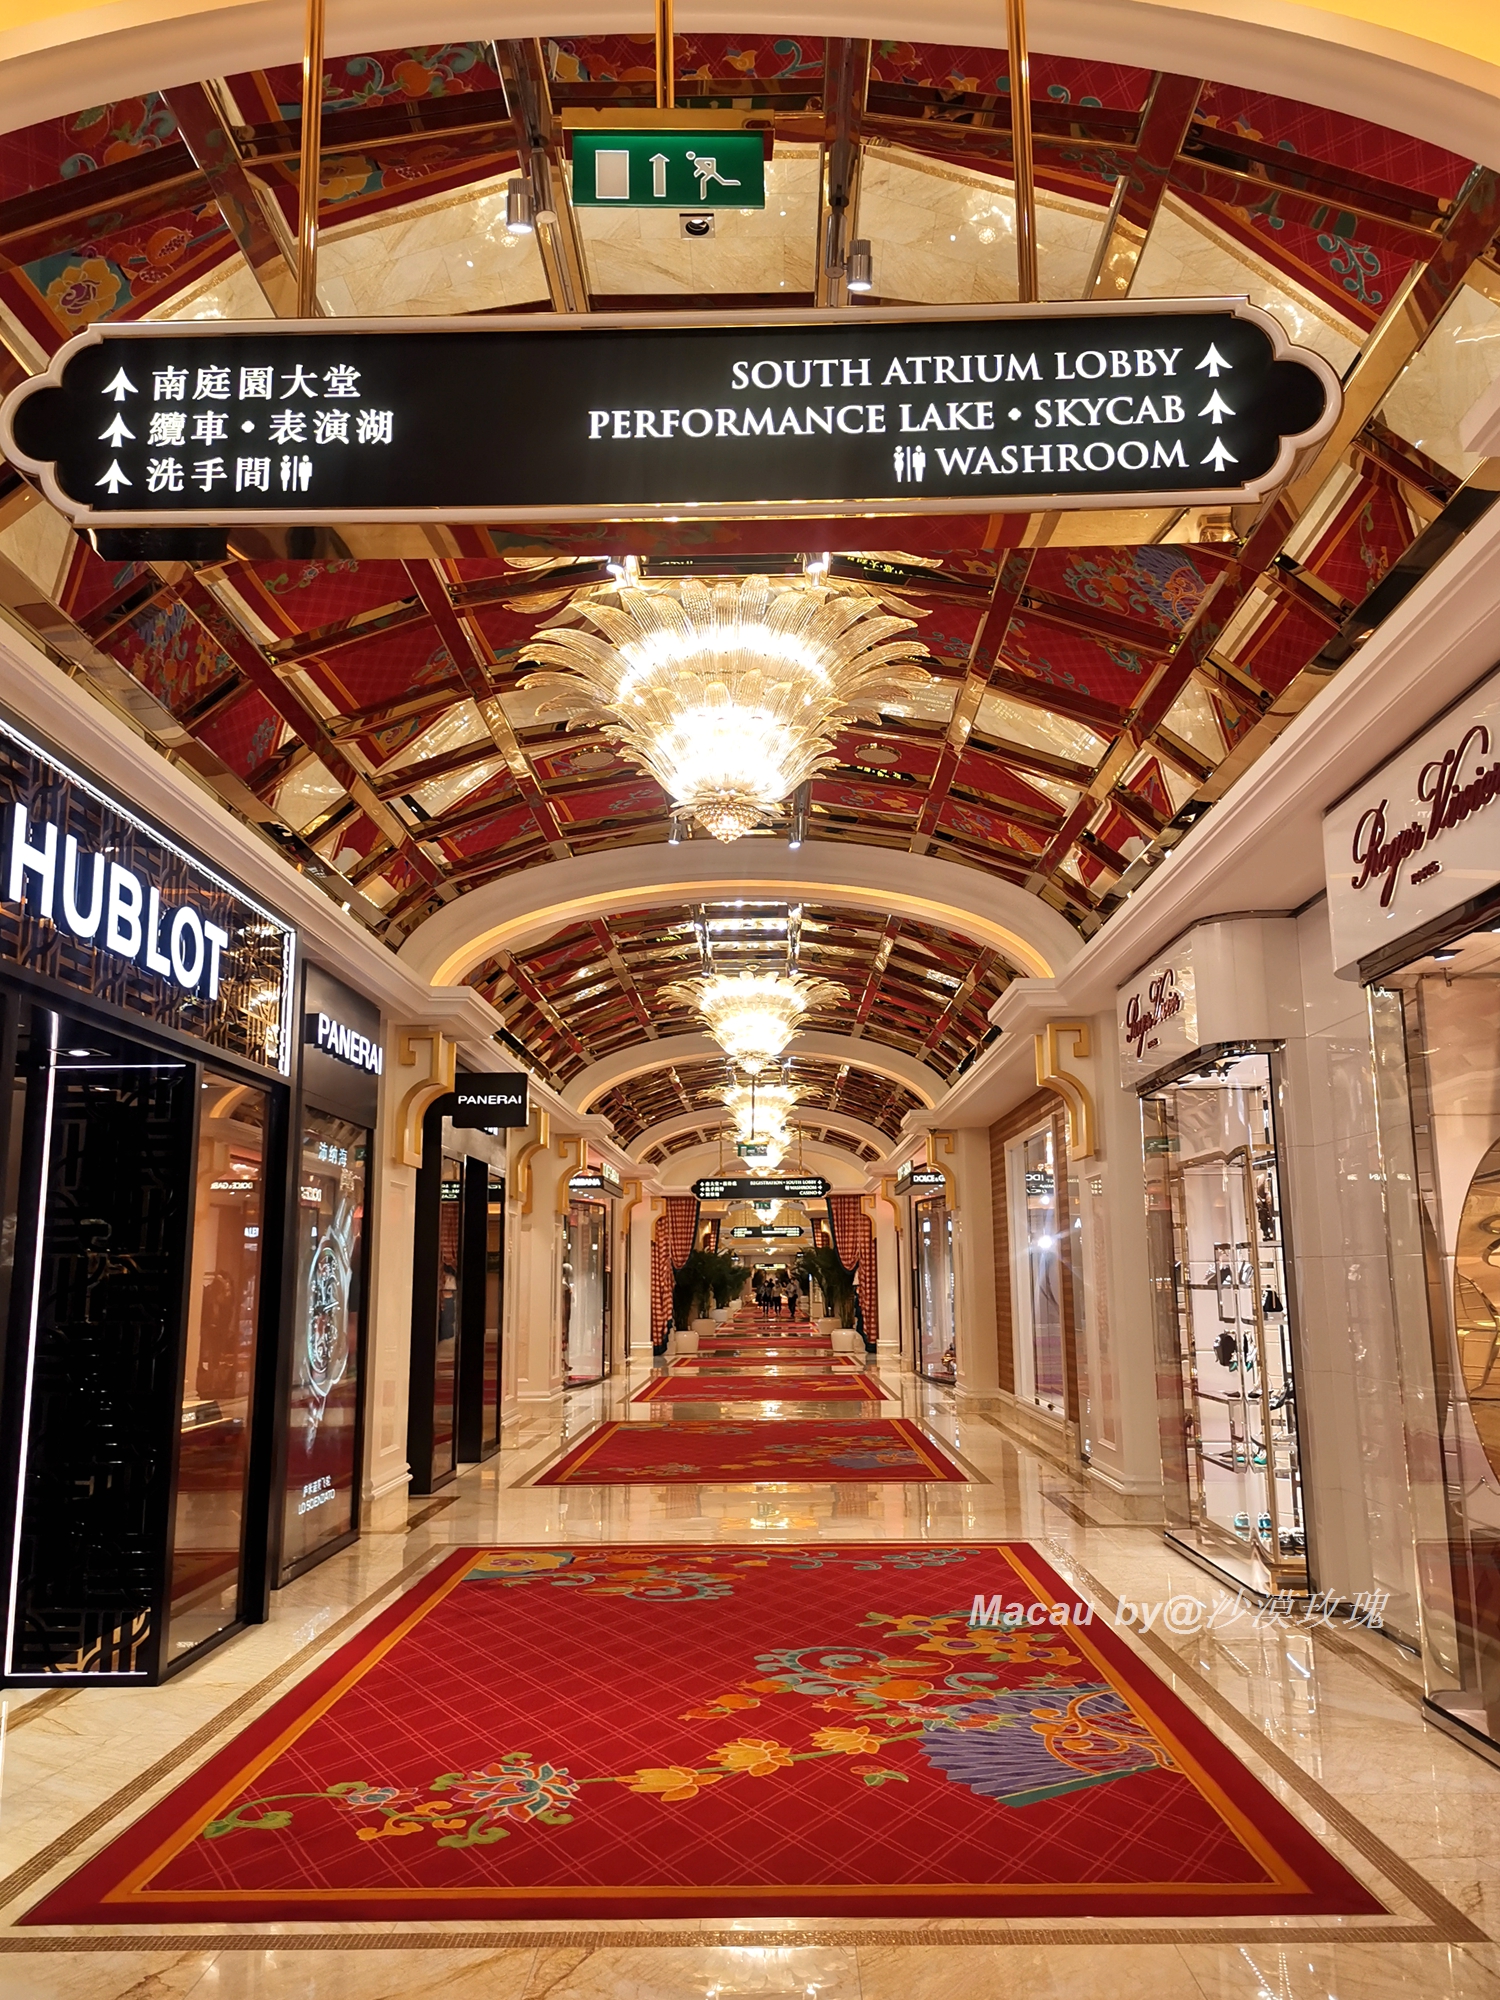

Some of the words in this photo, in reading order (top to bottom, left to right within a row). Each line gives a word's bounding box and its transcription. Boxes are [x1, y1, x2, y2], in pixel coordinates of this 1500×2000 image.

[151, 363, 362, 402] 南庭園大堂
[730, 356, 873, 390] SOUTH
[880, 351, 1045, 386] ATRIUM
[1054, 347, 1185, 380] LOBBY
[587, 404, 887, 440] PERFORMANCE
[898, 401, 995, 433] LAKE
[1034, 394, 1187, 429] SKYCAB
[145, 455, 273, 493] 洗手間
[933, 438, 1190, 476] WASHROOM
[9, 802, 229, 1001] HUBLOT
[318, 1012, 383, 1076] PANERAI
[457, 1094, 523, 1105] PANERAI
